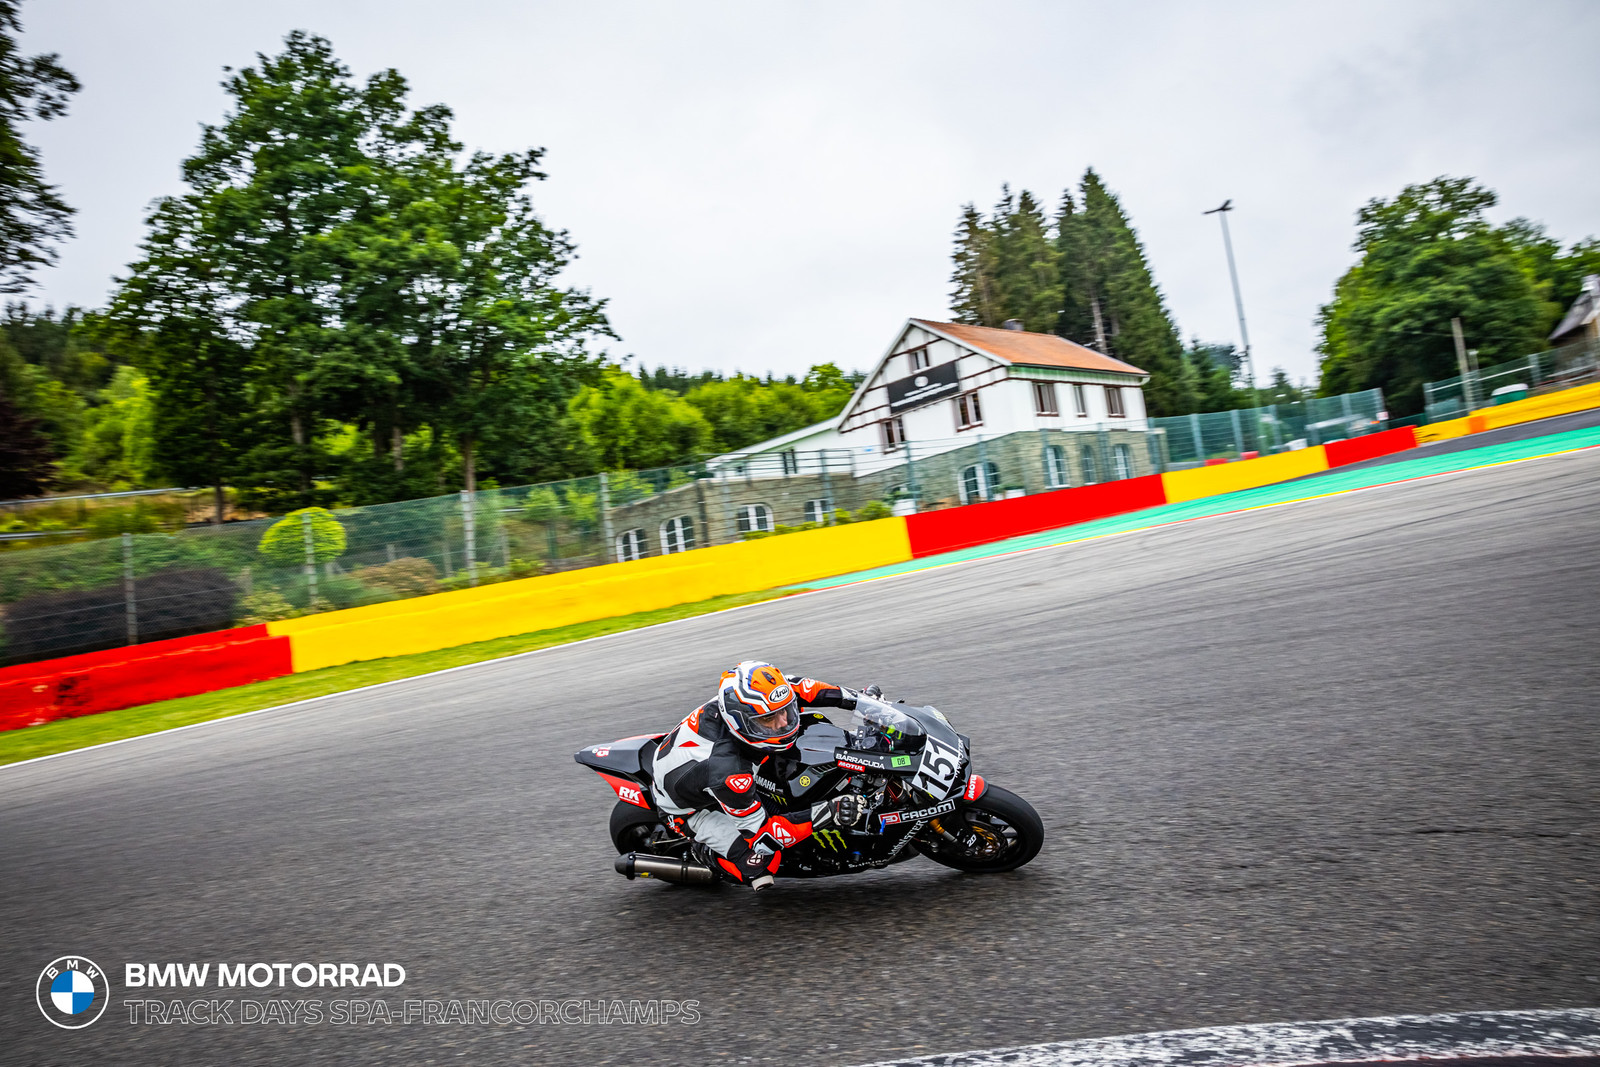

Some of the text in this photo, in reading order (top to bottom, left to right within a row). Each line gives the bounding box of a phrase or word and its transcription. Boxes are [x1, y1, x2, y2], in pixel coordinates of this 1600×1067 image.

[772, 687, 788, 701] Arai
[835, 753, 886, 770] BARRACUDA
[838, 761, 864, 771] MOTUL
[917, 736, 960, 793] 151
[752, 774, 776, 792] AMAHA
[967, 774, 978, 799] MOTU
[619, 786, 641, 801] RK
